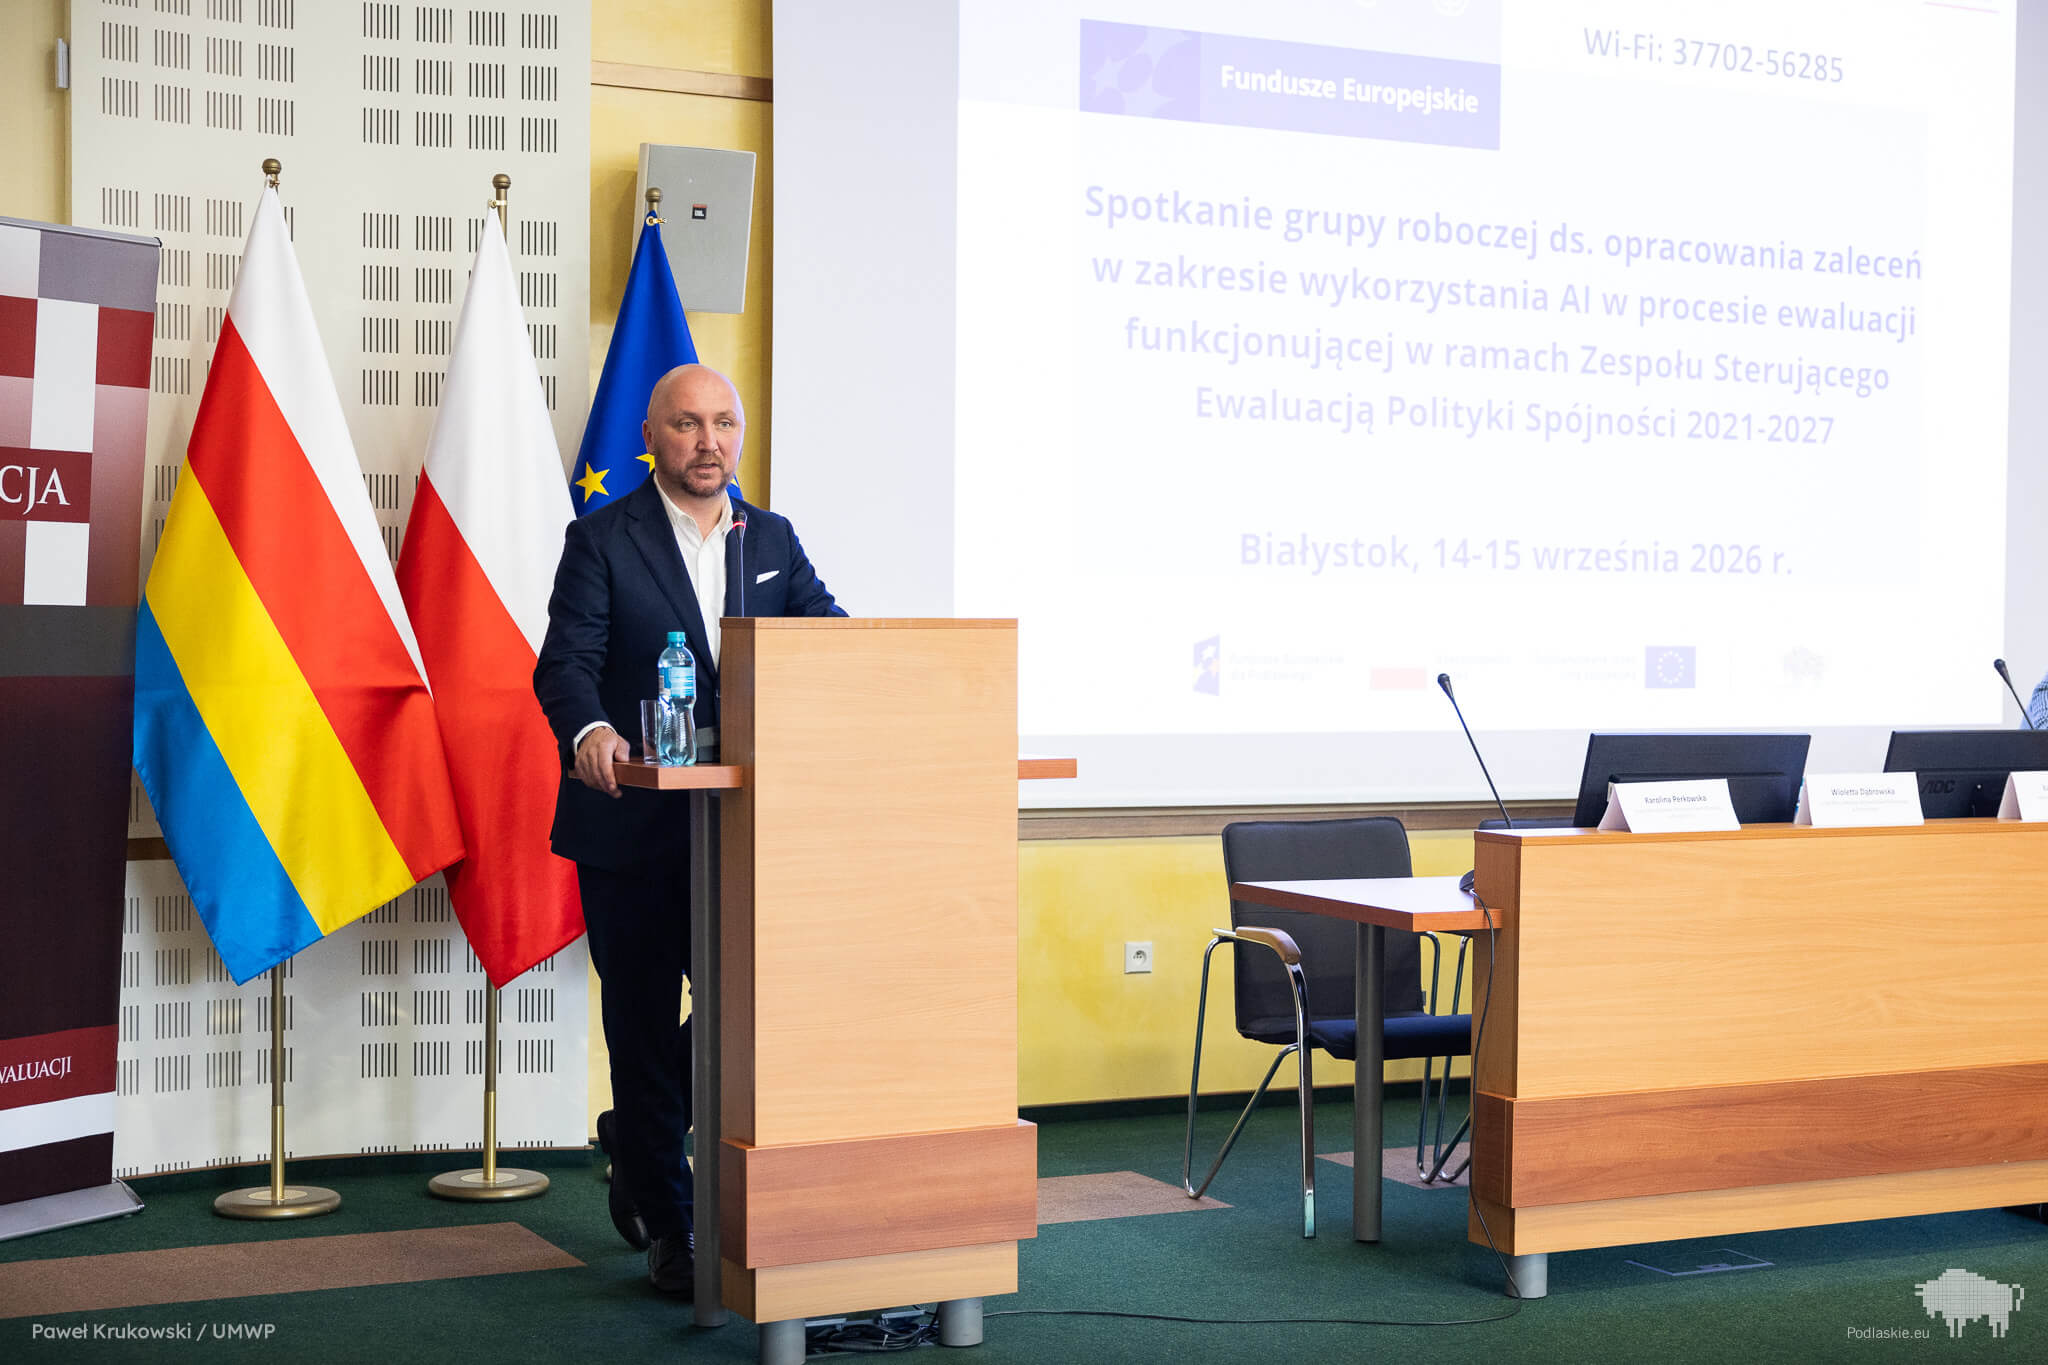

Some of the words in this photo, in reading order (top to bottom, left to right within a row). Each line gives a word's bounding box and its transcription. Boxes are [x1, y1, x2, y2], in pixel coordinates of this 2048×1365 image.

[1584, 28, 1662, 63] Wi-Fi:
[1673, 38, 1843, 83] 37702-56285
[1221, 65, 1337, 98] Fundusze
[1343, 78, 1479, 115] Europejskie
[1086, 185, 1272, 230] Spotkanie
[1284, 208, 1386, 248] grupy
[1398, 212, 1536, 260] roboczej
[1550, 222, 1592, 255] ds.
[1605, 234, 1803, 271] opracowania
[1813, 245, 1921, 280] zaleceń
[1092, 257, 1123, 283] w
[1136, 255, 1287, 294] zakresie
[1299, 267, 1548, 314] wykorzystania
[1560, 284, 1590, 314] AI
[1602, 293, 1628, 316] w
[1640, 295, 1767, 328] procesie
[1778, 301, 1915, 344] ewaluacji
[1125, 317, 1393, 373] funkcjonującej
[1405, 341, 1433, 365] w
[1446, 342, 1568, 373] ramach
[1580, 345, 1702, 386] Zespołu
[1714, 353, 1889, 398] Sterującego
[1197, 387, 1374, 434] Ewaluacją
[1388, 396, 1513, 439] Polityki
[1526, 402, 1676, 443] Spójności
[1687, 411, 1834, 444] 2021-2027
[1241, 532, 1419, 576] Białystok,
[1434, 538, 1521, 570] 14-15
[1532, 540, 1679, 573] września
[1690, 544, 1762, 574] 2026
[1773, 550, 1792, 575] r.
